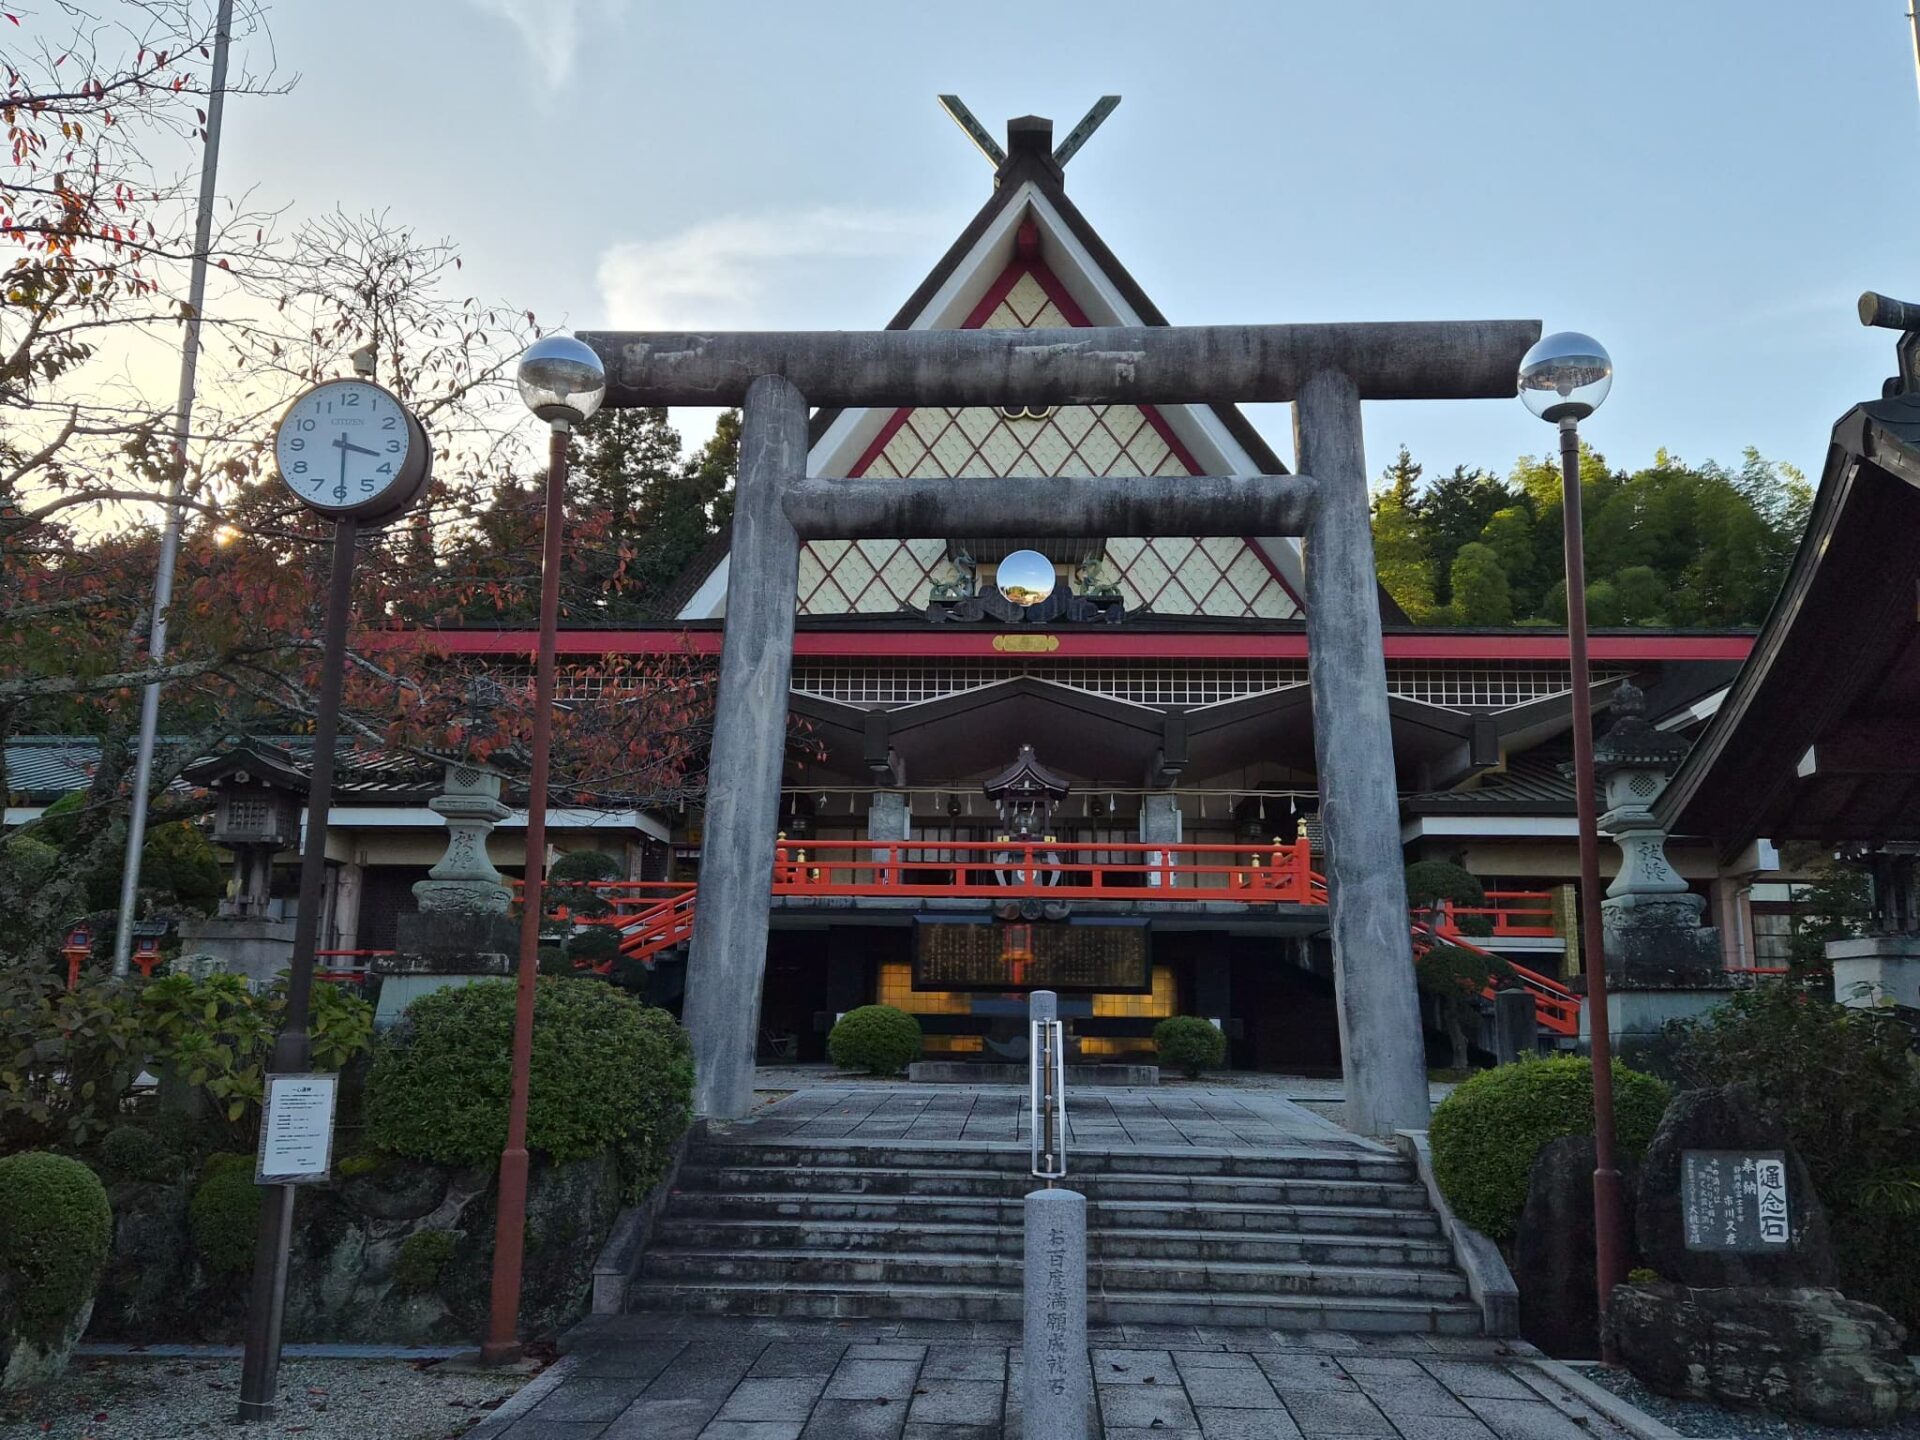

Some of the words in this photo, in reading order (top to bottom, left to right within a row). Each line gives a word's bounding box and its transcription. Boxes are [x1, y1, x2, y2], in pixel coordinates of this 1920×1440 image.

[341, 393, 359, 407] 12
[372, 399, 376, 411] 1
[316, 401, 332, 414] 11
[296, 418, 315, 431] 10
[381, 417, 396, 430] 2
[290, 438, 305, 452] 9
[385, 439, 400, 453] 3
[292, 461, 308, 474] 8
[376, 462, 392, 475] 4
[310, 479, 325, 492] 7
[333, 485, 348, 499] 6
[360, 479, 375, 493] 5
[1742, 1157, 1757, 1195] 奉納
[1760, 1165, 1786, 1237] 通念石
[1046, 1228, 1067, 1396] お百度満願成就石
